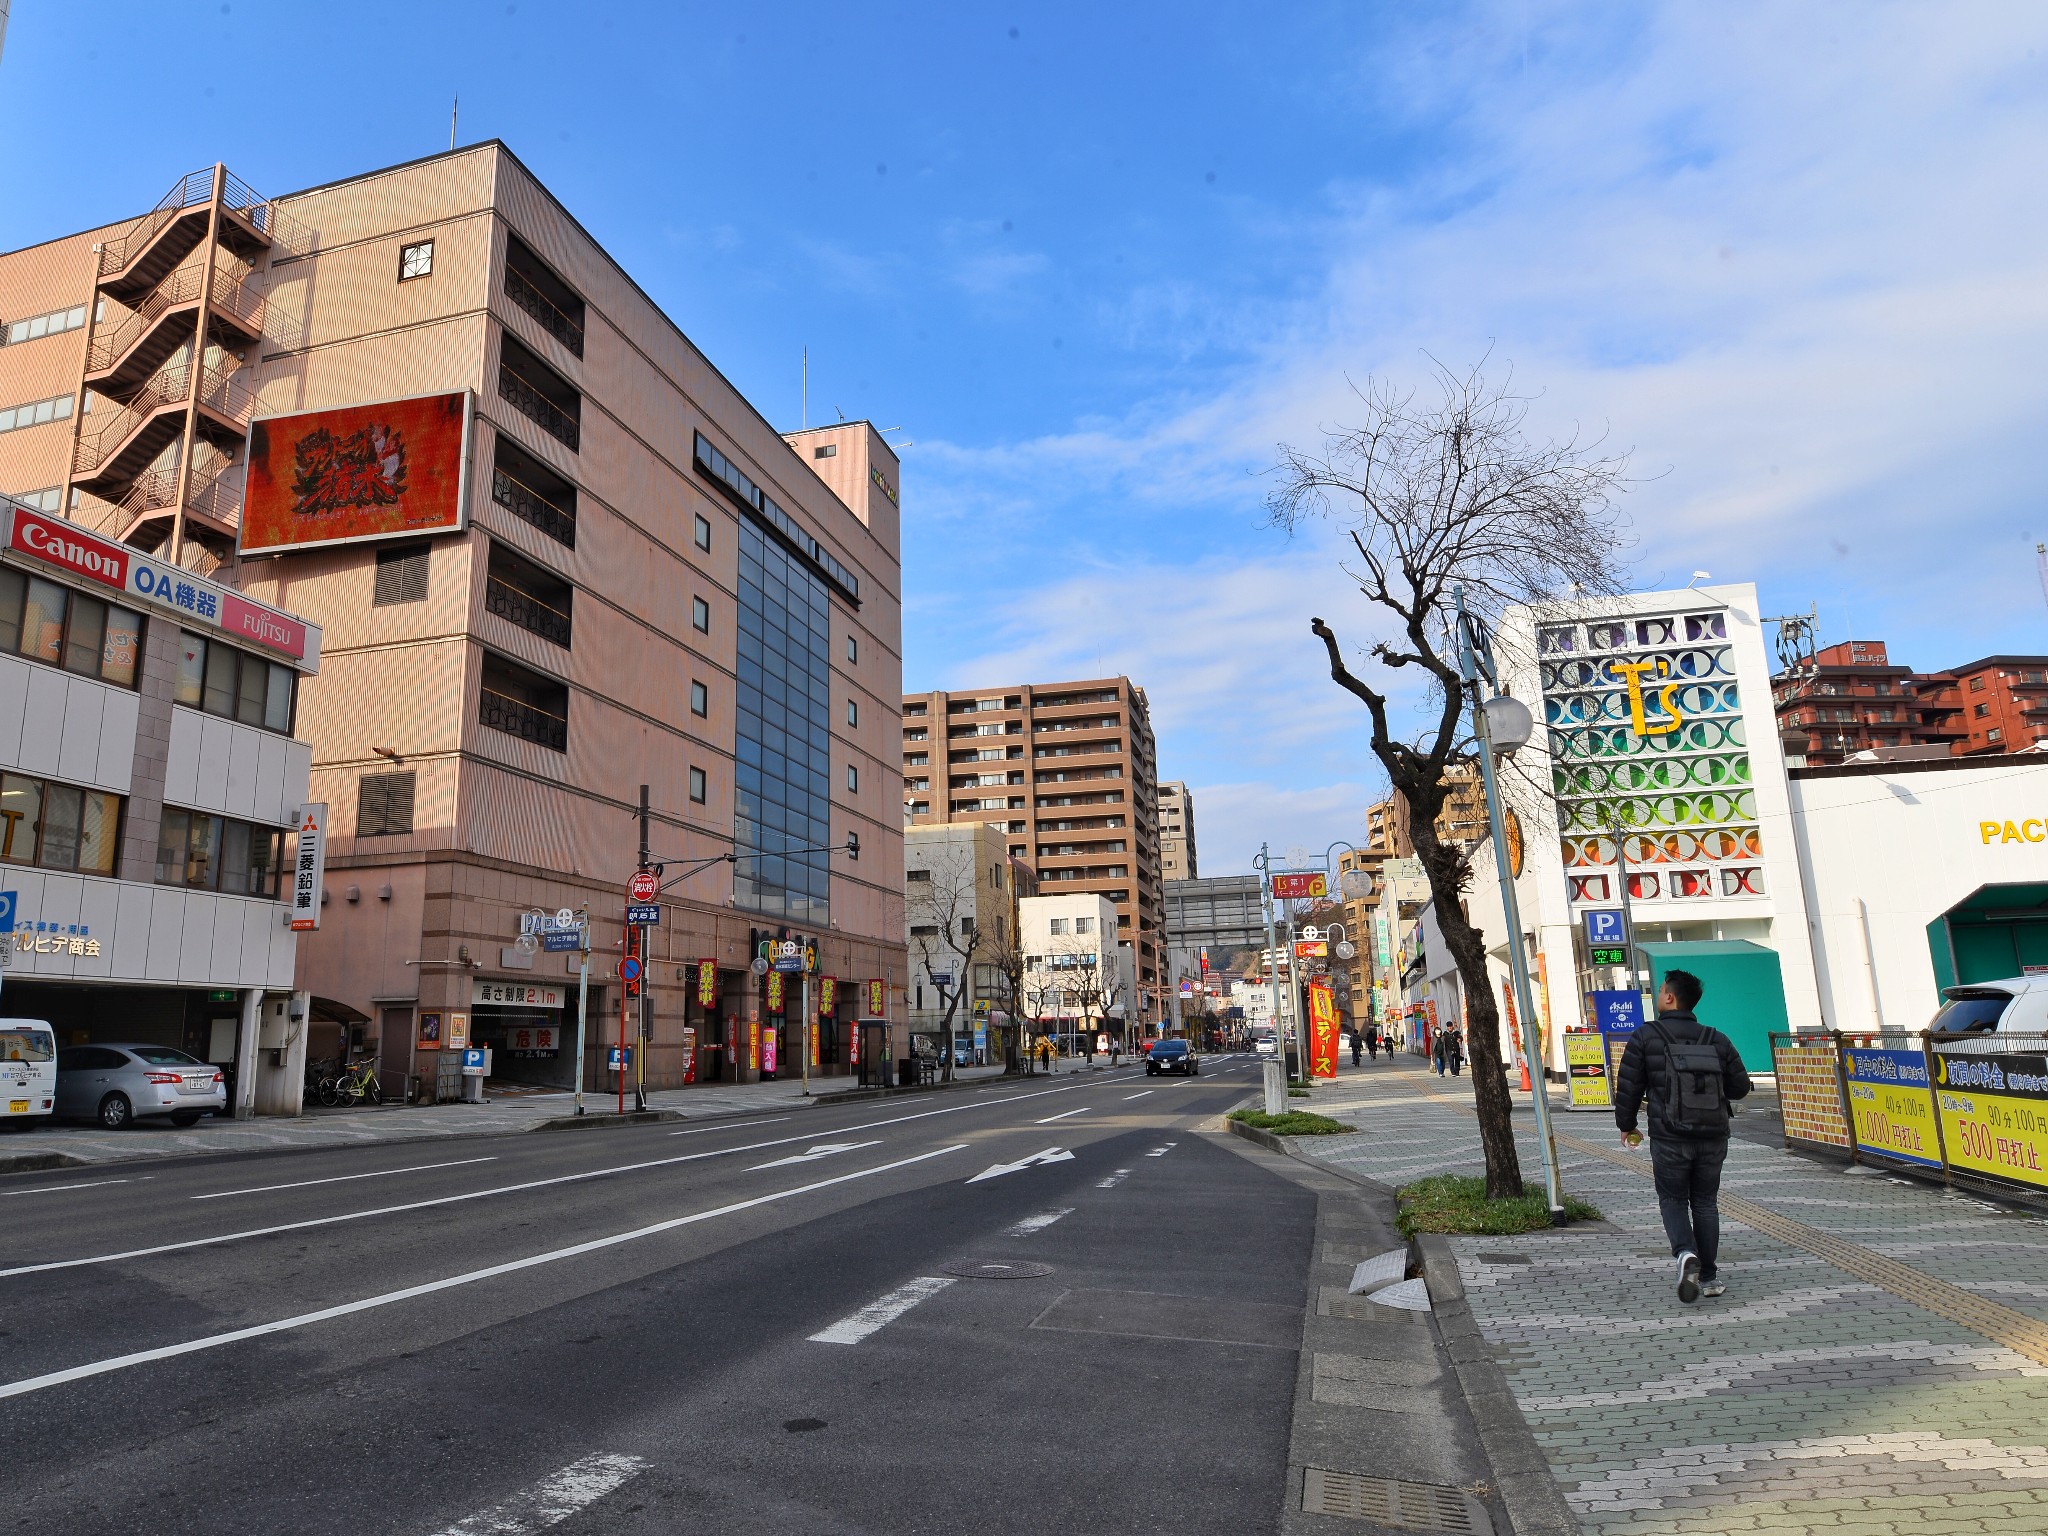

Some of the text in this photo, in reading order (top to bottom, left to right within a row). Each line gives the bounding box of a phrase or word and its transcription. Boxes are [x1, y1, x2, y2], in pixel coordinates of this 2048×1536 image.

[22, 523, 119, 579] Canon
[135, 566, 216, 619] OA機器
[243, 612, 291, 646] FUJITSU
[1609, 661, 1683, 736] T's
[1980, 819, 2048, 844] PAC
[296, 835, 316, 909] 三菱鉛筆
[634, 882, 653, 893] 消火栓
[1275, 876, 1304, 890] T's 第1
[1276, 889, 1307, 897] パーキング
[1313, 882, 1323, 894] P
[629, 911, 658, 921] 明石屋
[1596, 914, 1615, 934] P
[12, 932, 101, 957] ルヒデ商会
[1594, 934, 1621, 942] 駐車場
[1594, 950, 1624, 964] 空車
[481, 984, 557, 1005] 高さ制限2.1m
[1609, 1001, 1633, 1010] Asahi
[515, 1029, 552, 1048] 危険
[467, 1051, 480, 1066] P
[1855, 1055, 1898, 1079] 日中の料金
[1946, 1060, 2006, 1090] 夜間の料金
[1987, 1104, 2048, 1135] 90分100円
[1958, 1119, 2043, 1171] 500円打止
